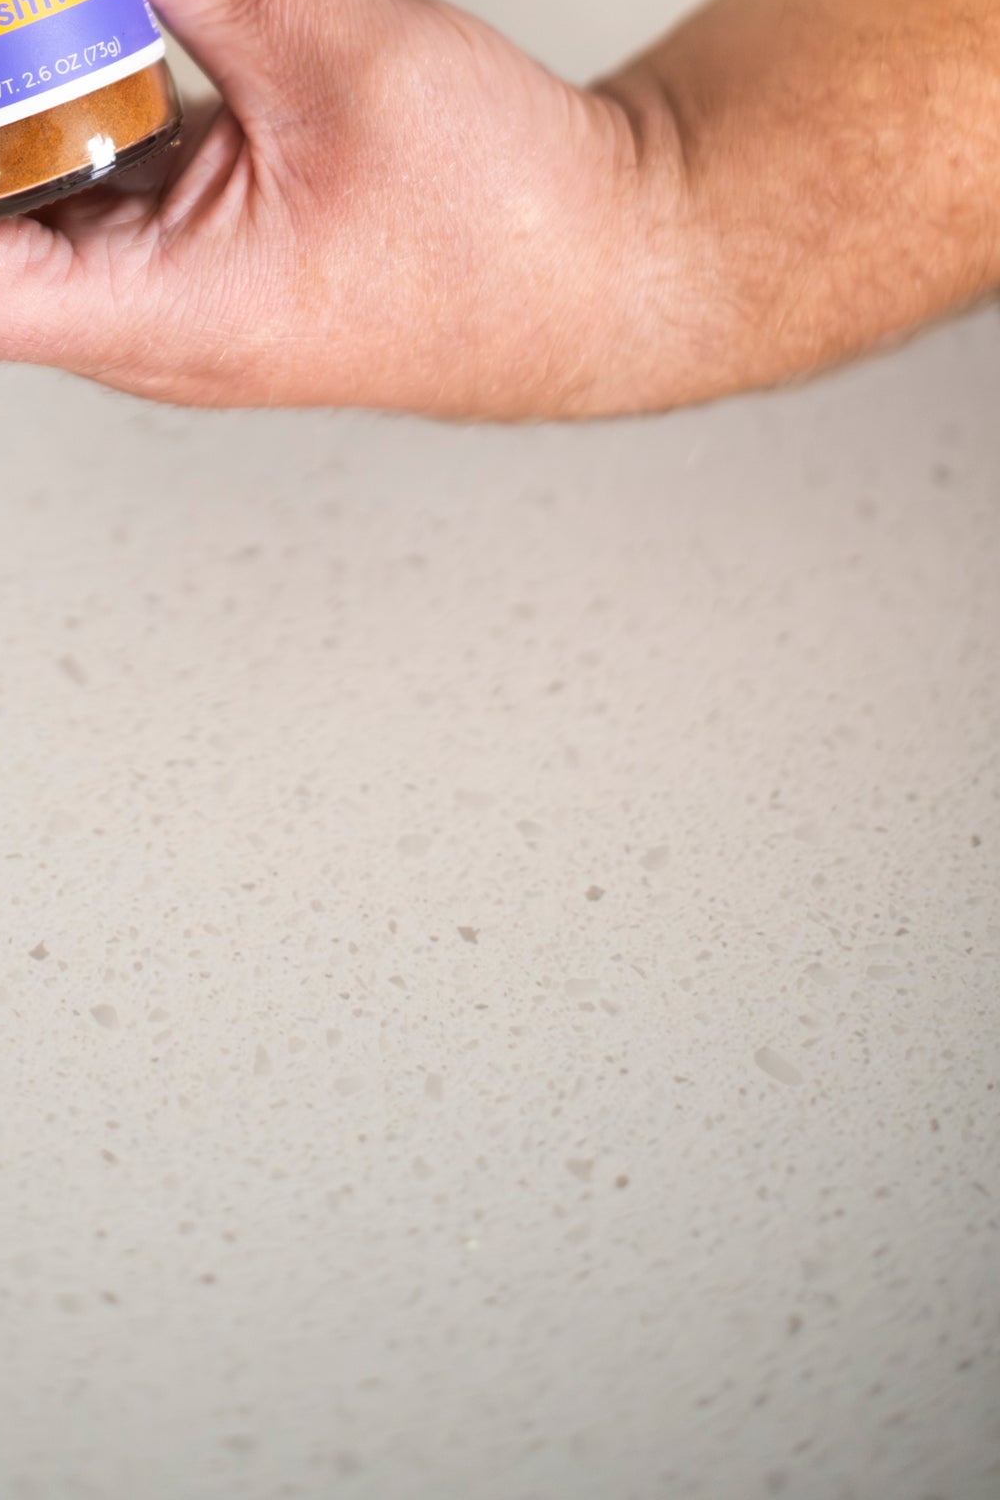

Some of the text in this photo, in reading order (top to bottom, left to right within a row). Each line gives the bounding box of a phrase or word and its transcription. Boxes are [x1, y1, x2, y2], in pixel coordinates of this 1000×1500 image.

[21, 65, 52, 89] 2.6
[54, 53, 82, 75] OZ
[83, 35, 122, 67] (73g)
